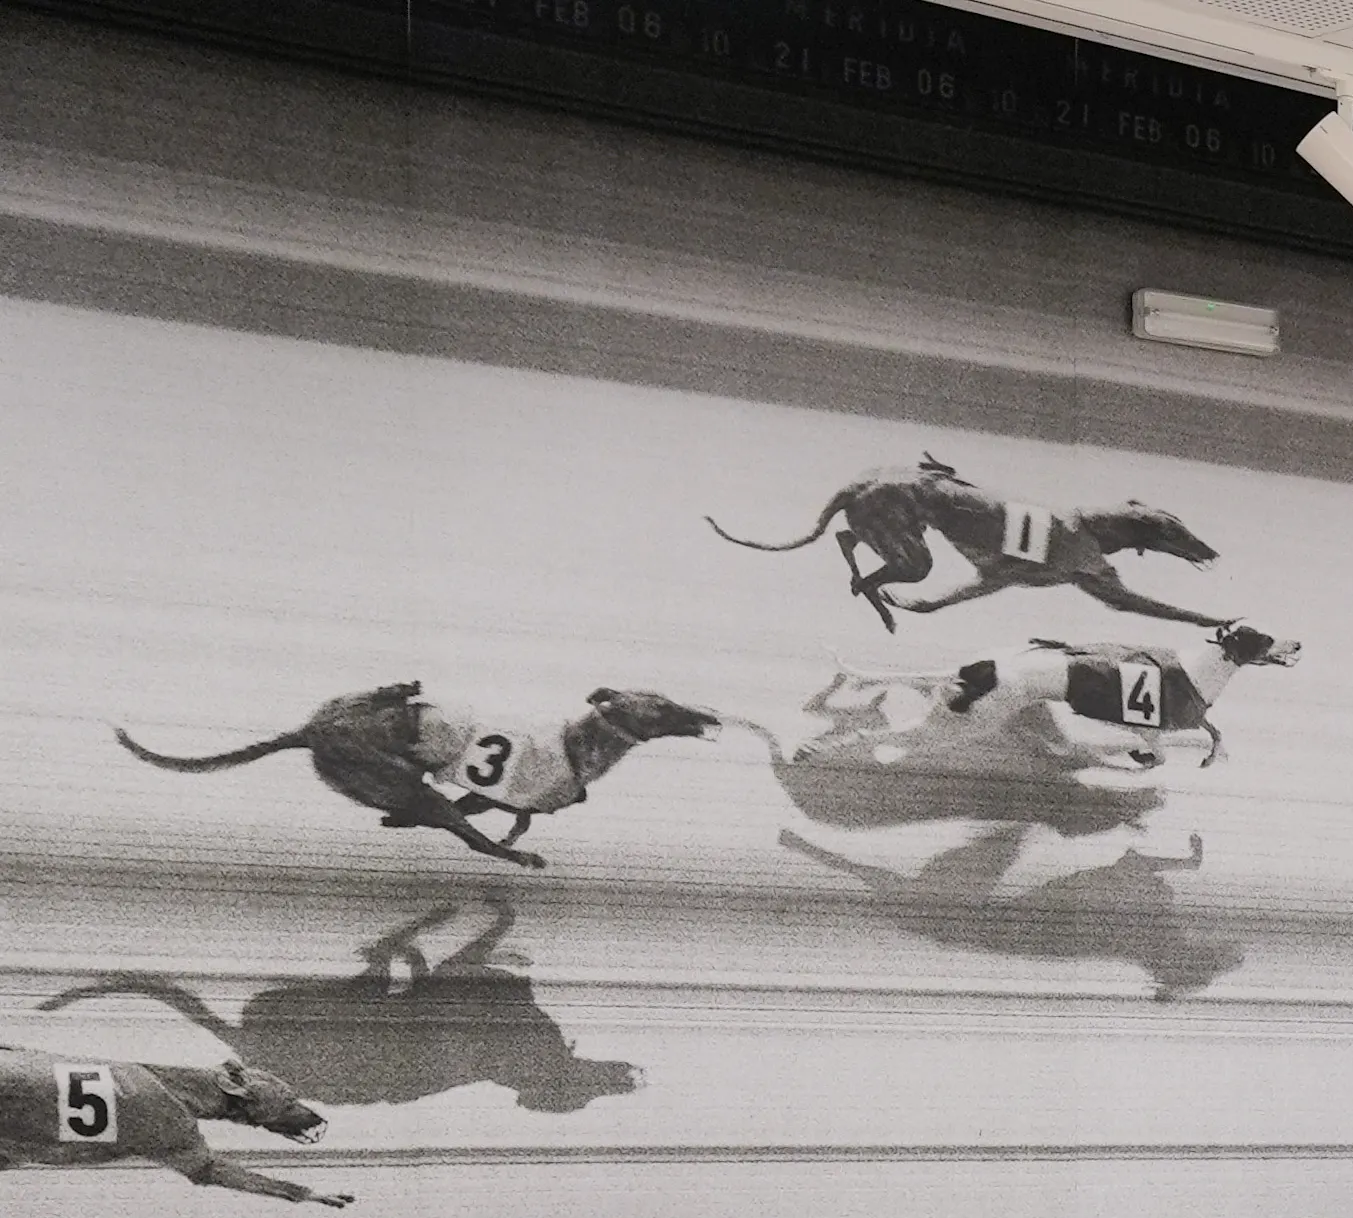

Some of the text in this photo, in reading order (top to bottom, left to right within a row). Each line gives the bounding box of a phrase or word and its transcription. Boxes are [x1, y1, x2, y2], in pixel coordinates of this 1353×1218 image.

[844, 57, 891, 90] FEB
[918, 69, 954, 99] 06
[1118, 111, 1162, 143] FEB
[1186, 124, 1221, 152] 06
[1019, 512, 1032, 553] 1
[1128, 670, 1154, 720] 4
[466, 734, 512, 787] 3
[67, 1071, 108, 1137] 5
